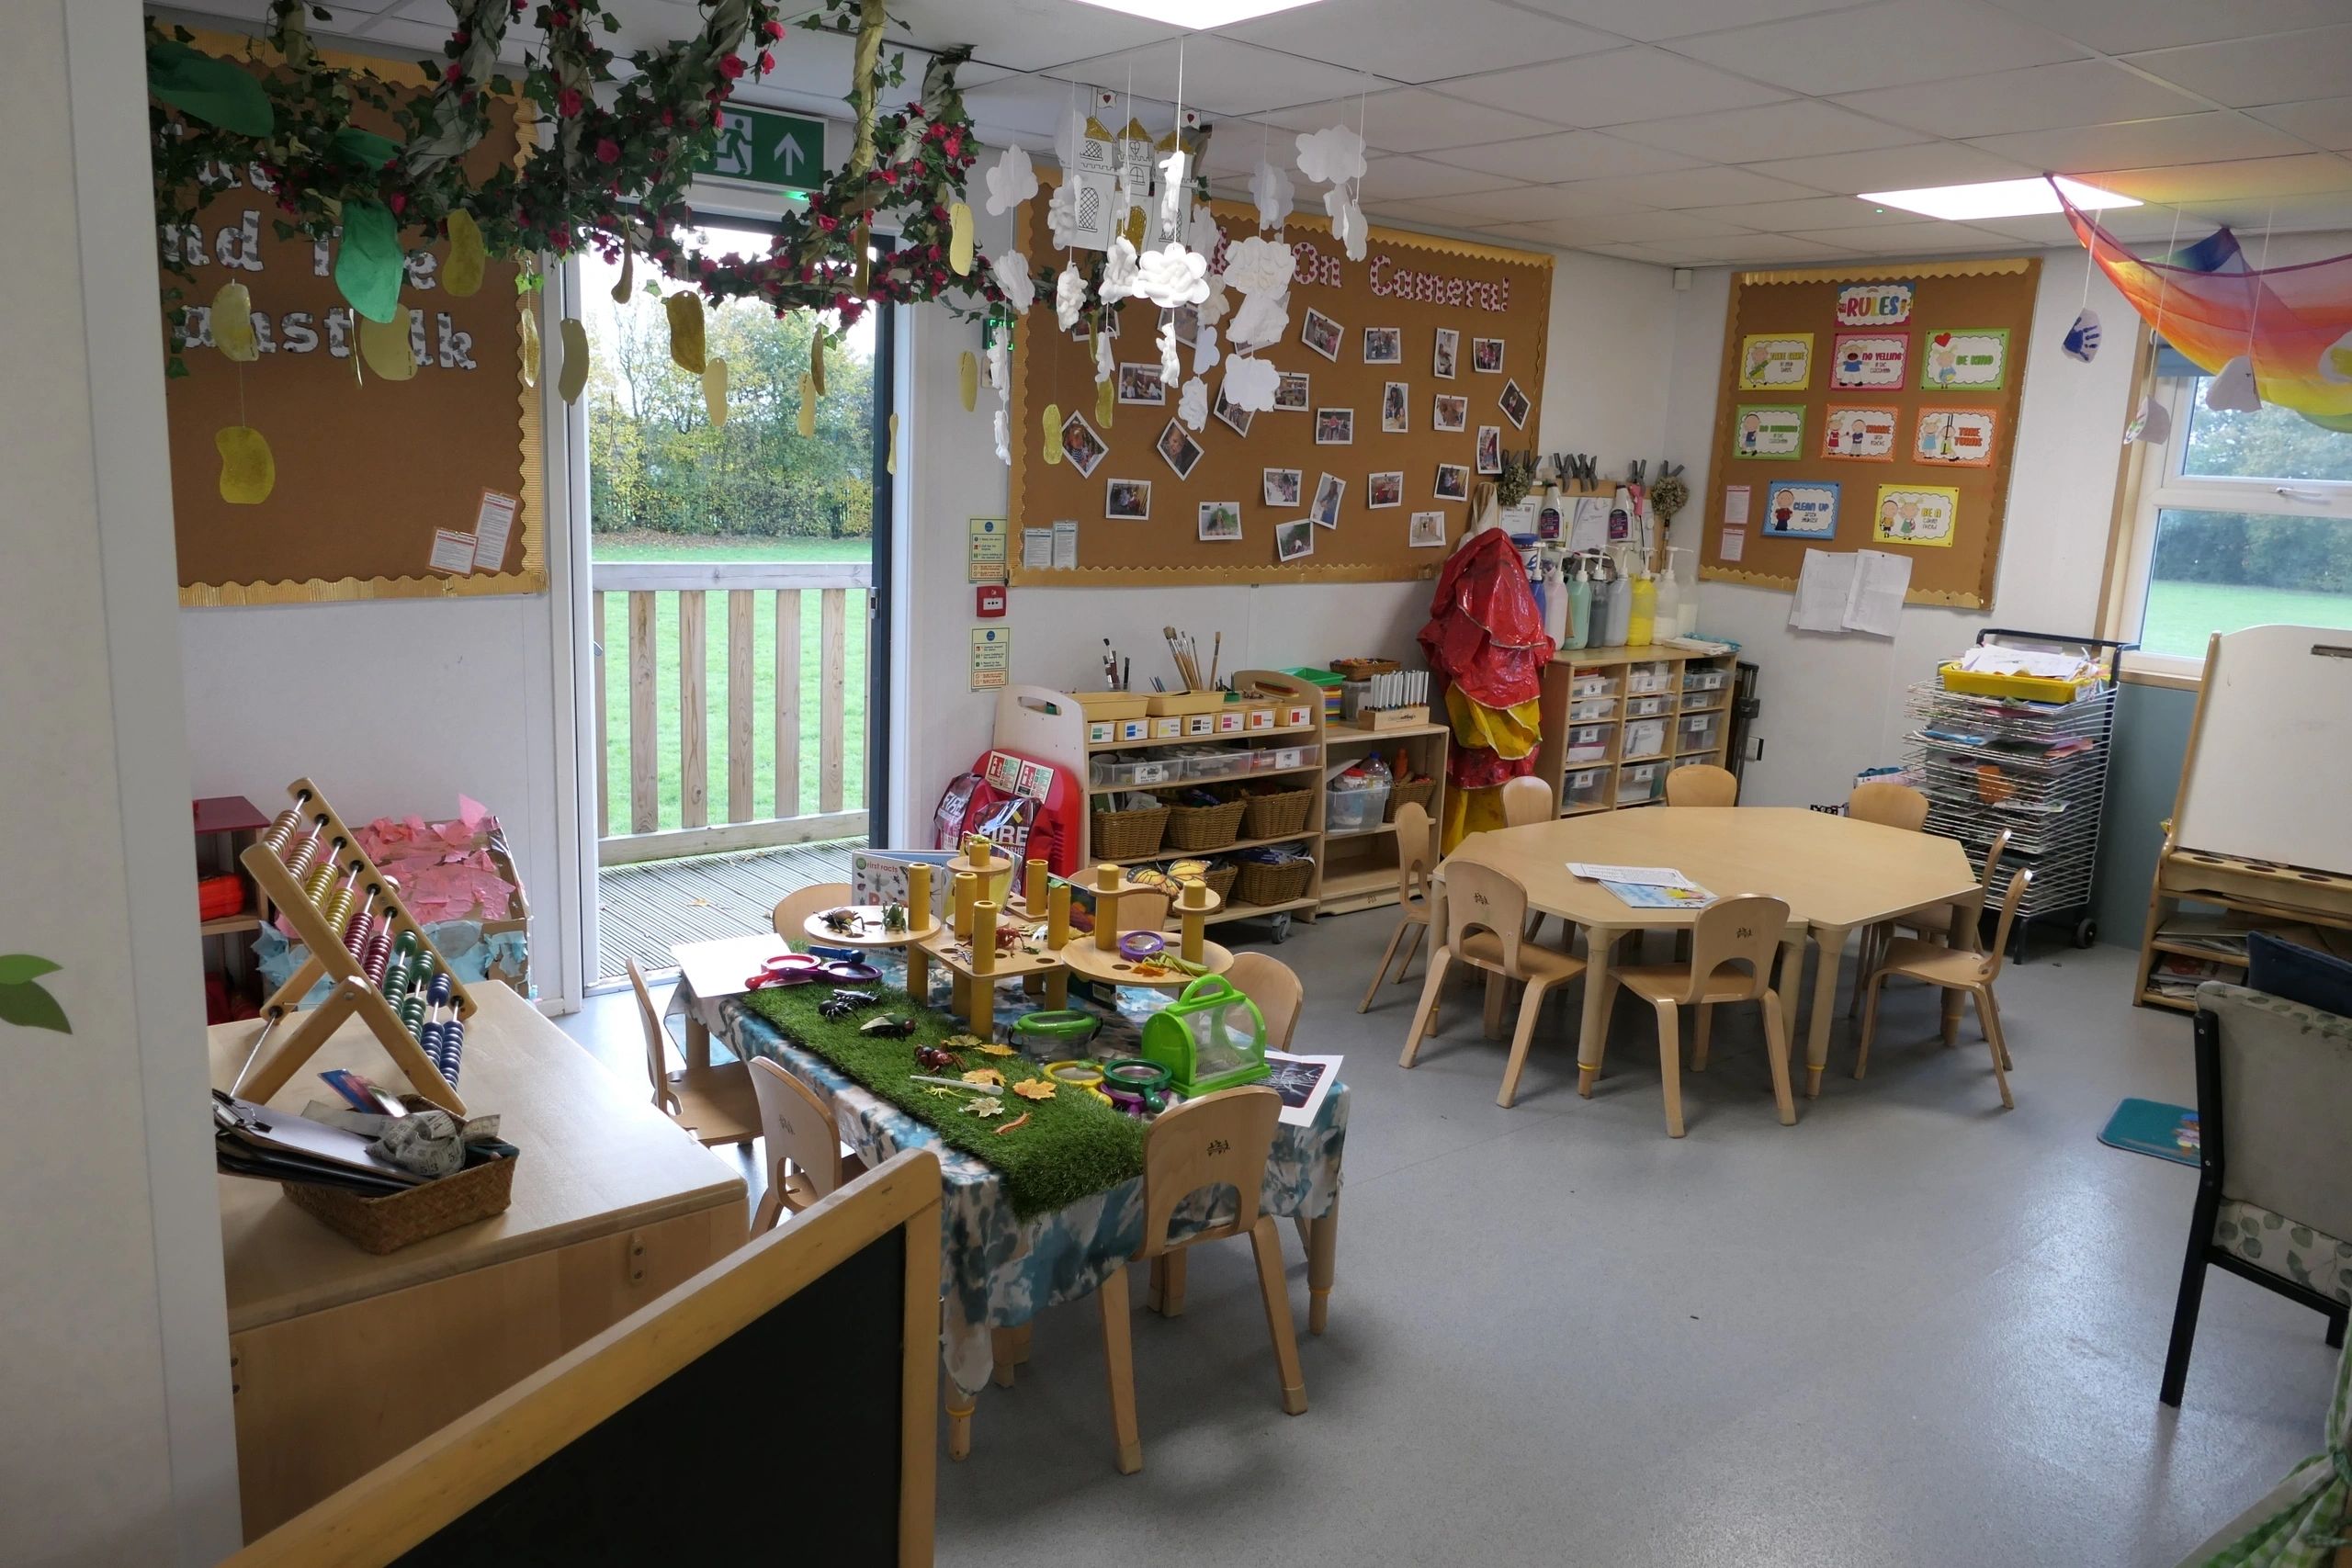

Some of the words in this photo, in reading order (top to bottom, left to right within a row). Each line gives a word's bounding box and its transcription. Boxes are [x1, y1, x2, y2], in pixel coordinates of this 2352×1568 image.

[1292, 241, 1342, 289] On
[1369, 254, 1510, 312] Camera!
[1847, 296, 1900, 318] RULES
[1861, 353, 1872, 361] NO
[1875, 353, 1902, 361] YELLING
[1793, 502, 1816, 512] CLEAN
[1818, 502, 1829, 513] UP
